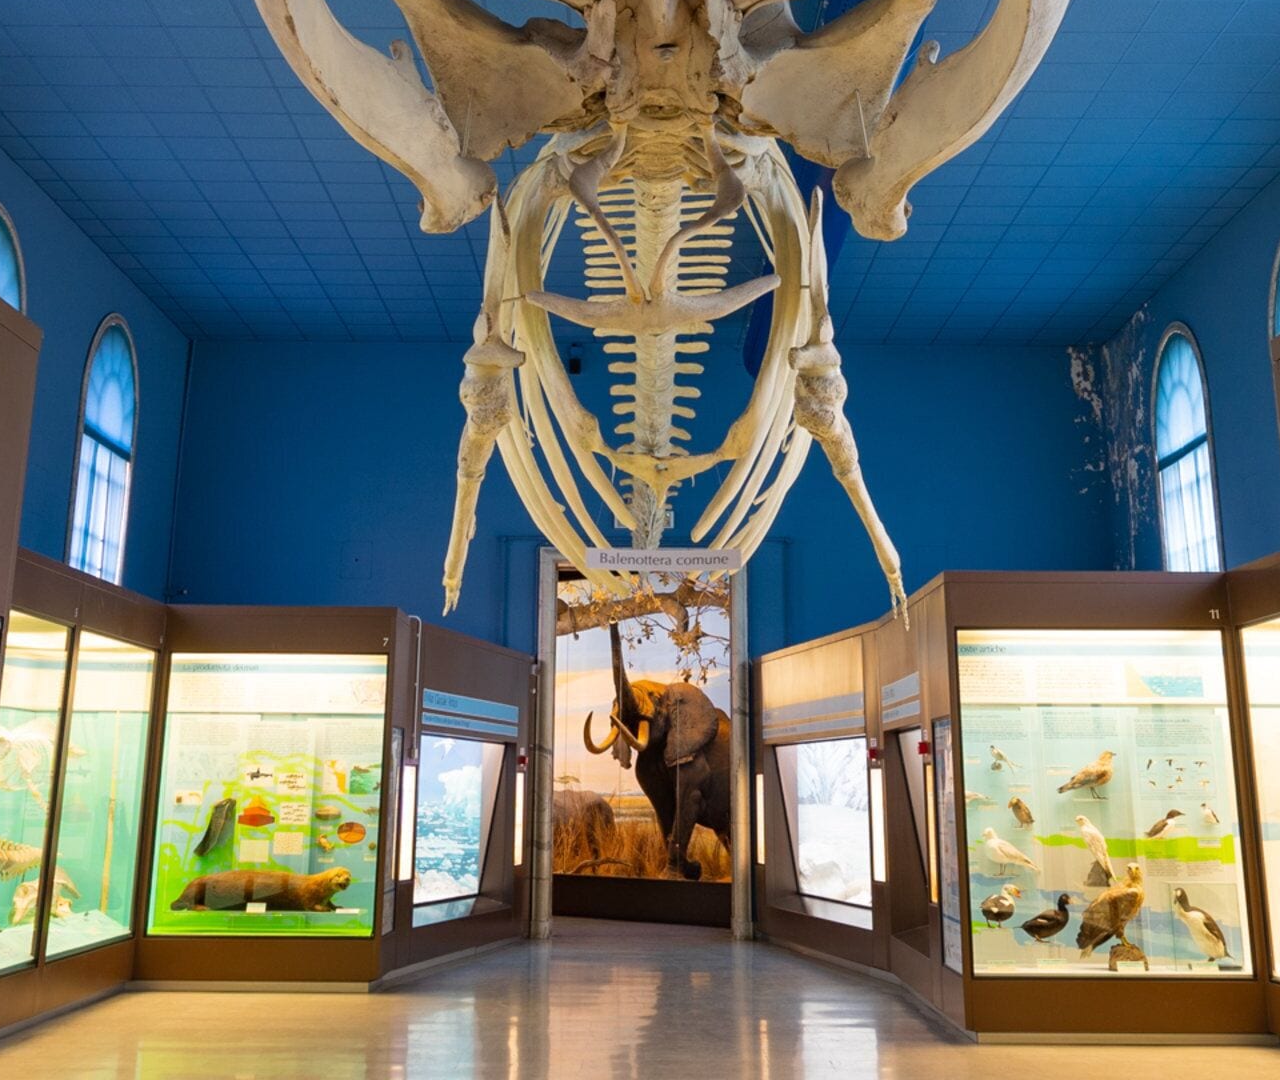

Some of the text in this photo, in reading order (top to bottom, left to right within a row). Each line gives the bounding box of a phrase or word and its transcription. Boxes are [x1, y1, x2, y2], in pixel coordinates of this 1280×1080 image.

[599, 551, 730, 567] Balenottera comune
[1208, 608, 1220, 620] 11
[382, 637, 389, 647] 7
